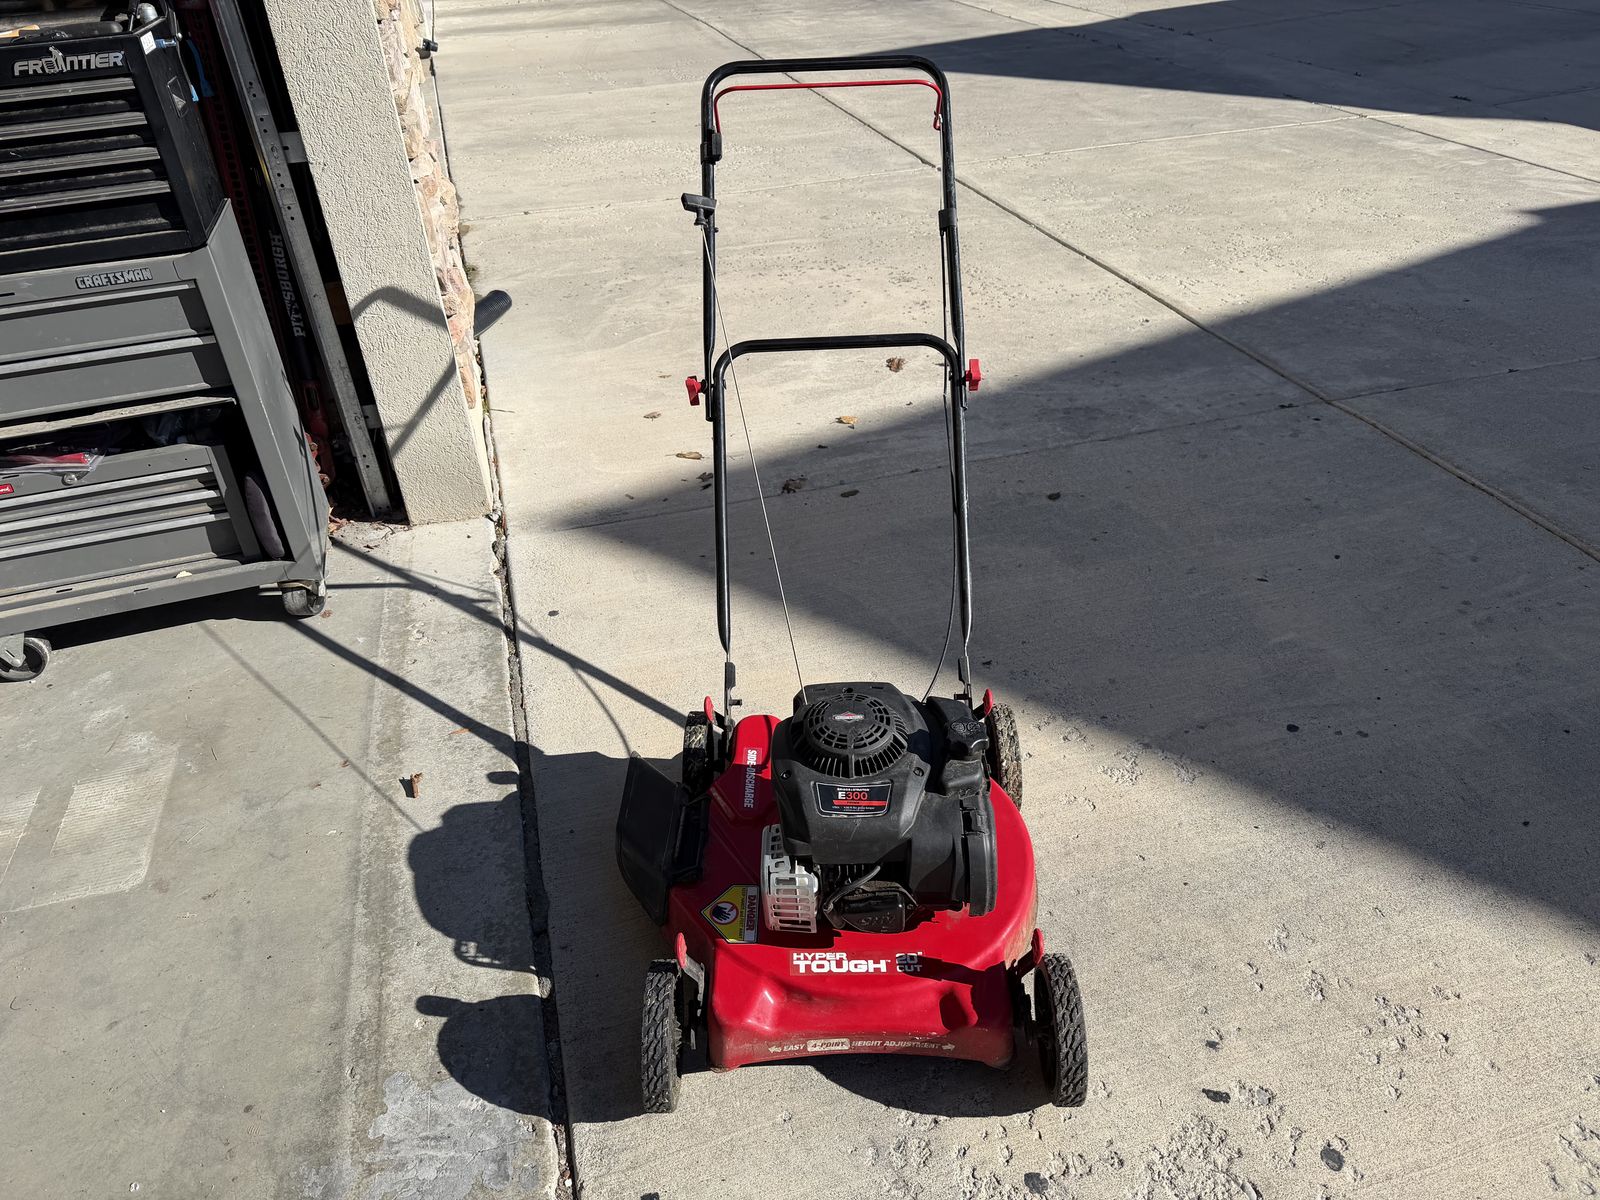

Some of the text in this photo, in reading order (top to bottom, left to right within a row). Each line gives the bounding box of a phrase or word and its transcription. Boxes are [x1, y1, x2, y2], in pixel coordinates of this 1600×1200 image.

[75, 267, 153, 289] CRAFTSMAN
[270, 234, 306, 337] PITTSBURGH
[743, 749, 757, 809] SIDE-DISCHARGE
[838, 791, 868, 800] E300
[746, 894, 757, 931] DANGER
[793, 952, 848, 960] HYPER
[793, 959, 888, 973] TOUGH
[896, 964, 923, 972] CUT
[782, 1043, 806, 1052] EASY
[811, 1041, 846, 1049] 4-POINT
[883, 1040, 940, 1049] ADJUSTMENT
